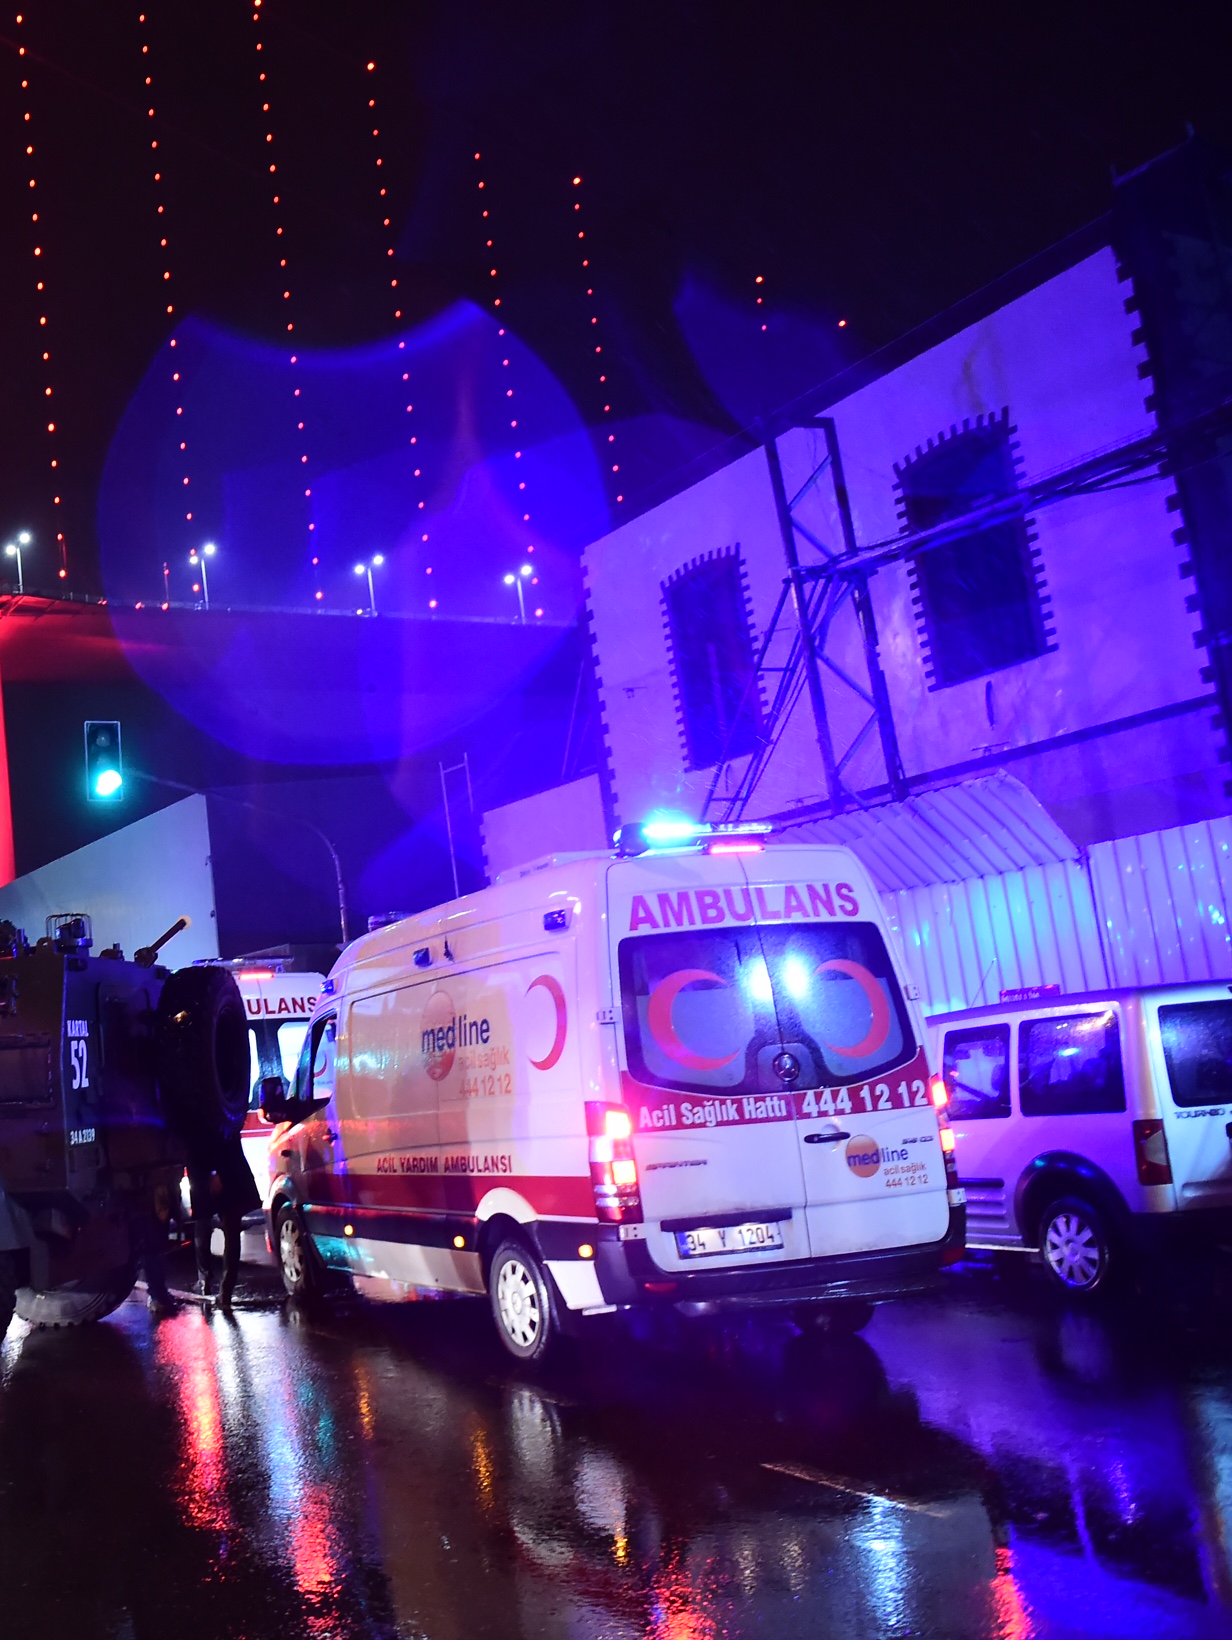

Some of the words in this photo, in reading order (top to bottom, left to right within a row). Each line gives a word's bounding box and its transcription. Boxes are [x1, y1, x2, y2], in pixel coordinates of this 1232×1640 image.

[629, 882, 860, 931] AMBULANS
[246, 996, 317, 1015] ULANS
[67, 1020, 89, 1037] KARTAL
[422, 1014, 490, 1052] medline
[70, 1039, 90, 1090] 52
[459, 1076, 479, 1098] 444
[481, 1075, 495, 1096] 12
[497, 1073, 512, 1095] 12
[639, 1103, 677, 1128] Acil
[680, 1099, 740, 1127] Sağlık
[742, 1096, 787, 1119] Hattı
[802, 1087, 853, 1117] 444
[860, 1083, 892, 1111] 12
[898, 1079, 928, 1107] 12
[399, 1156, 439, 1173] YARDIM
[444, 1155, 512, 1174] AMBULANSI
[848, 1147, 909, 1166] medline
[883, 1165, 900, 1176] acil
[901, 1162, 927, 1174] sağlık
[885, 1177, 903, 1188] 444
[904, 1175, 916, 1186] 12
[917, 1174, 929, 1185] 12
[686, 1233, 706, 1251] 34
[718, 1230, 726, 1248] Y
[738, 1226, 775, 1246] 1204
